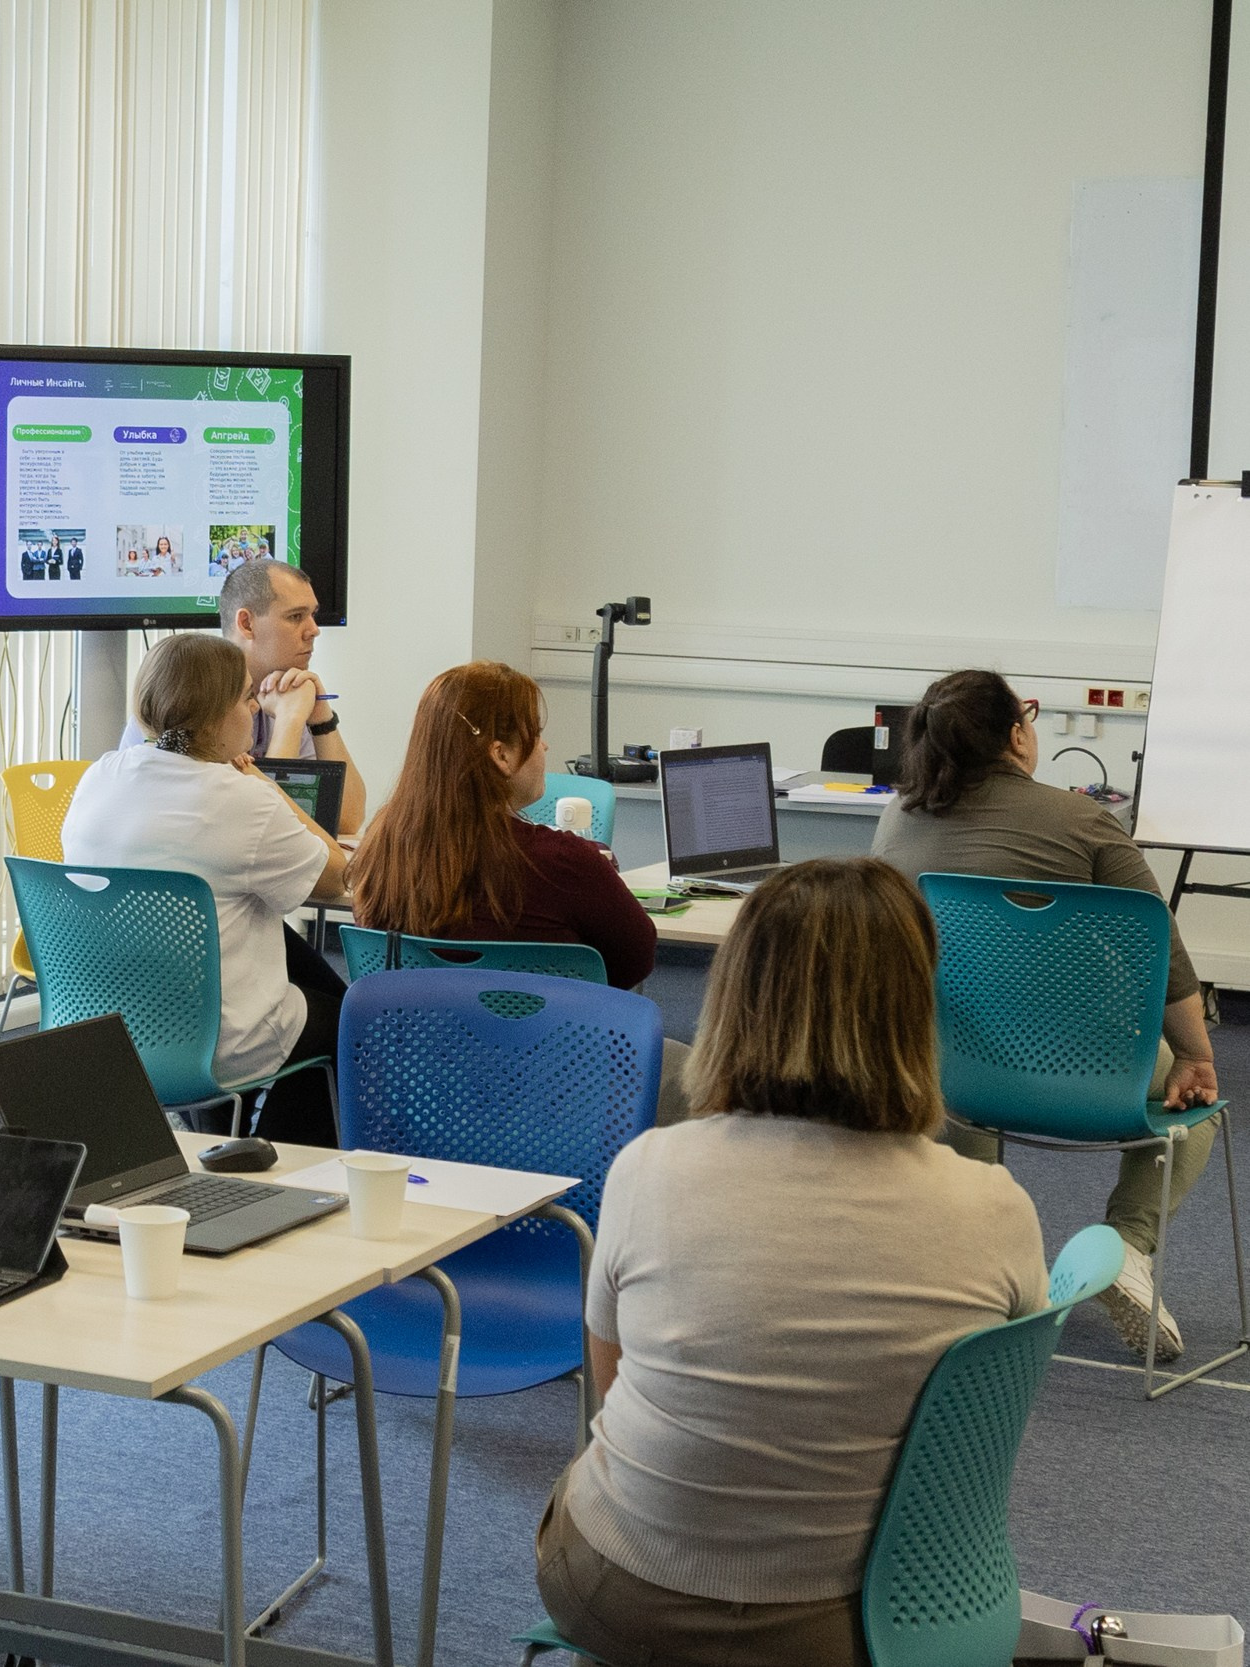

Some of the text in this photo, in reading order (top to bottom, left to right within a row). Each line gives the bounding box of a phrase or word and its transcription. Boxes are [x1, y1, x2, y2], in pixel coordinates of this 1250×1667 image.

[10, 377, 87, 388] Личные Инсайты.
[16, 427, 81, 436] Профессионализм
[122, 430, 157, 440] Улыбка
[211, 431, 250, 441] Апгрейд
